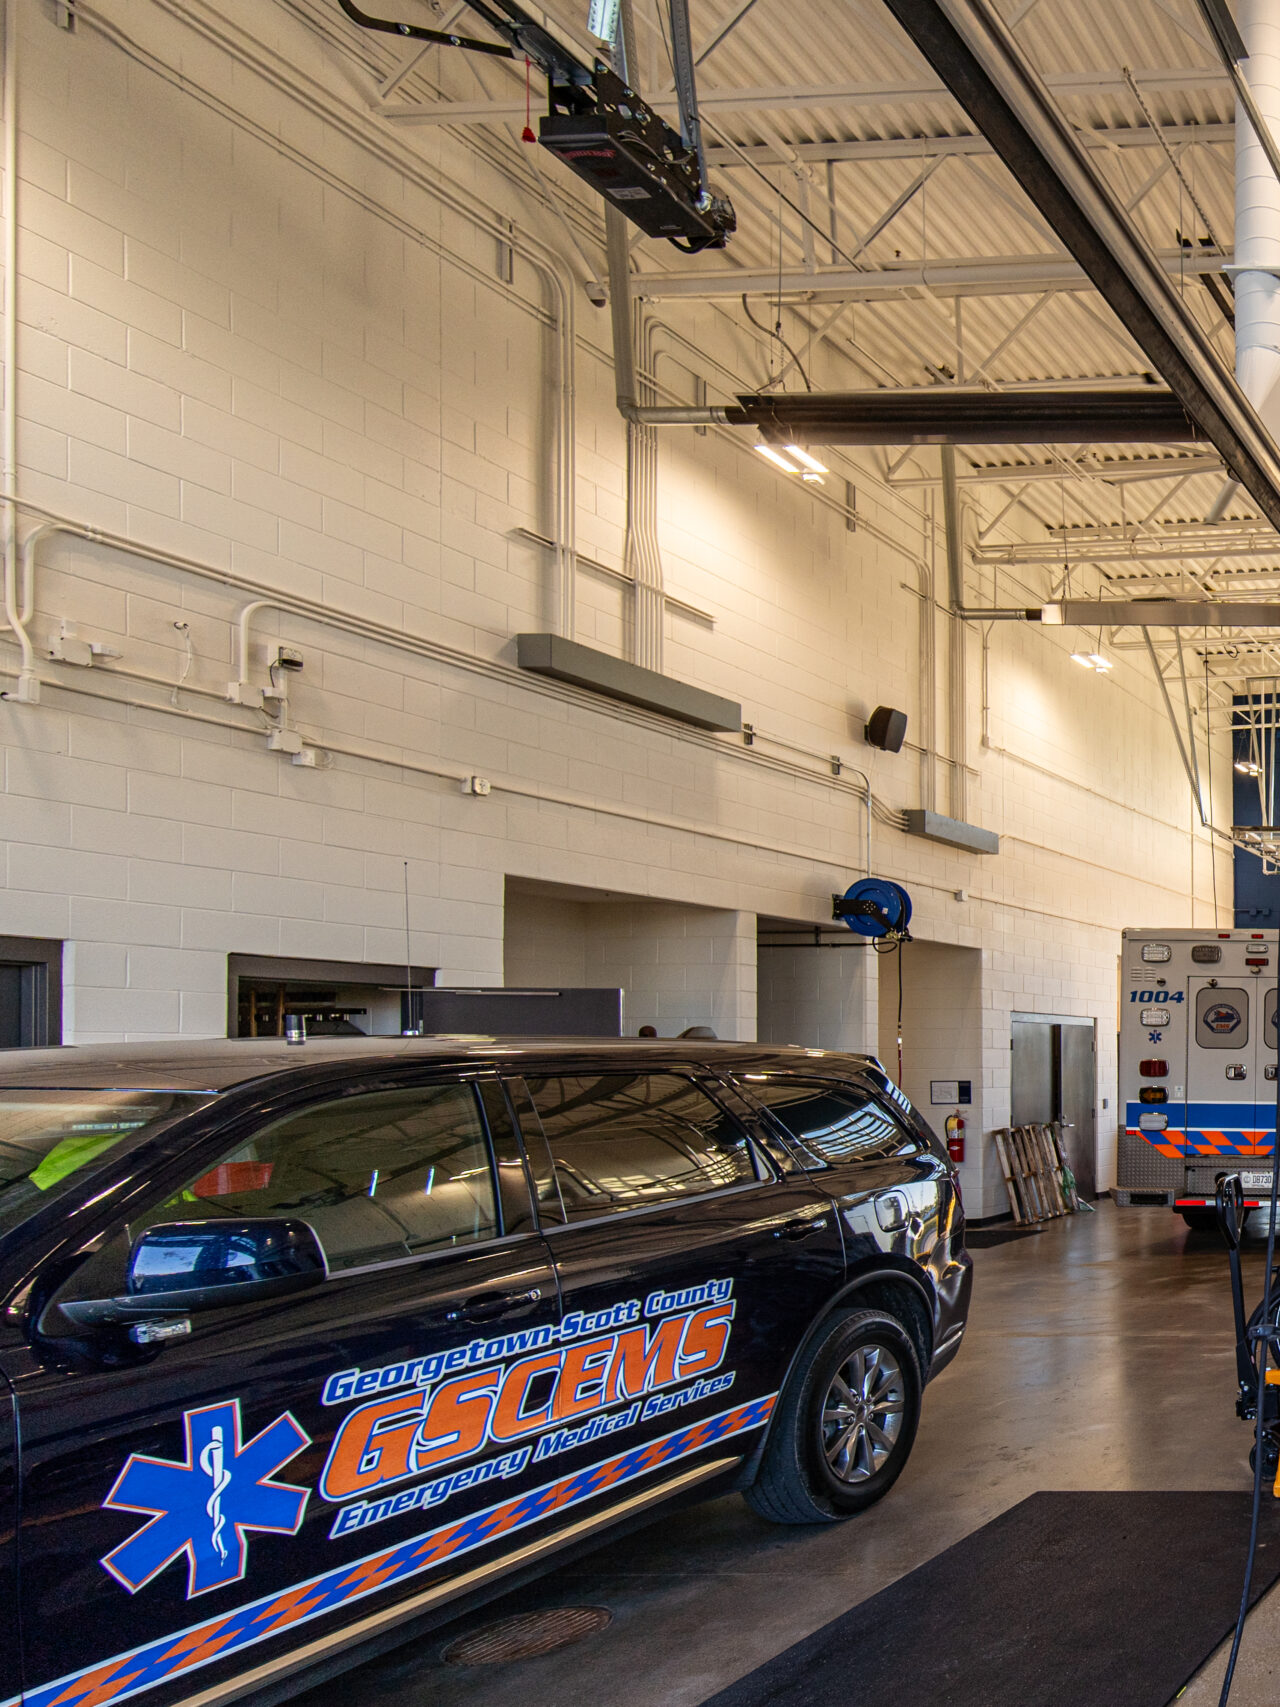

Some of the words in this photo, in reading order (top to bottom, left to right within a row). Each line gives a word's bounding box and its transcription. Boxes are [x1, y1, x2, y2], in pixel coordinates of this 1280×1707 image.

[1130, 990, 1184, 1003] 1004
[320, 1299, 736, 1502] GSCEMS
[322, 1299, 641, 1405] Georgetown-Scott
[644, 1277, 734, 1317] County
[329, 1446, 531, 1539] Emergency
[532, 1402, 643, 1463] Medical
[641, 1371, 736, 1419] Services
